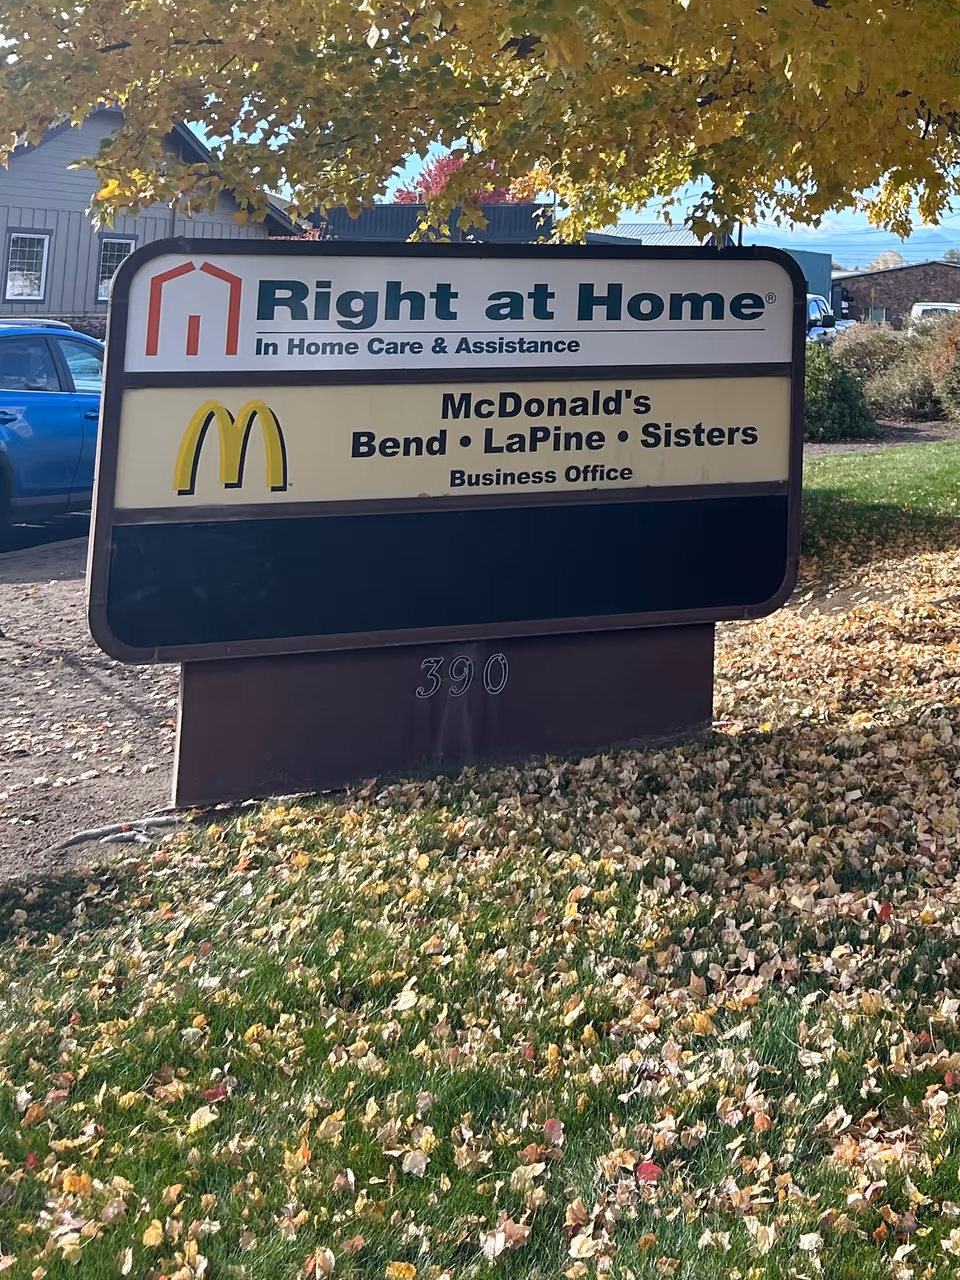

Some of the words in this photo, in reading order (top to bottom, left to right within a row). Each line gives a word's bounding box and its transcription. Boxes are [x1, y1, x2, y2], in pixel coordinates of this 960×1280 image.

[256, 280, 459, 330] Right
[485, 283, 556, 320] at
[255, 338, 278, 356] In
[287, 338, 360, 356] Home
[367, 337, 424, 355] Care
[431, 337, 448, 354] &
[455, 336, 581, 354] Assistance
[441, 389, 652, 420] McDonald's
[351, 429, 448, 458] Bend
[483, 426, 606, 455] LaPine
[640, 422, 759, 449] Sisters
[450, 468, 557, 488] Business
[564, 464, 634, 483] Office
[415, 652, 509, 699] 390
